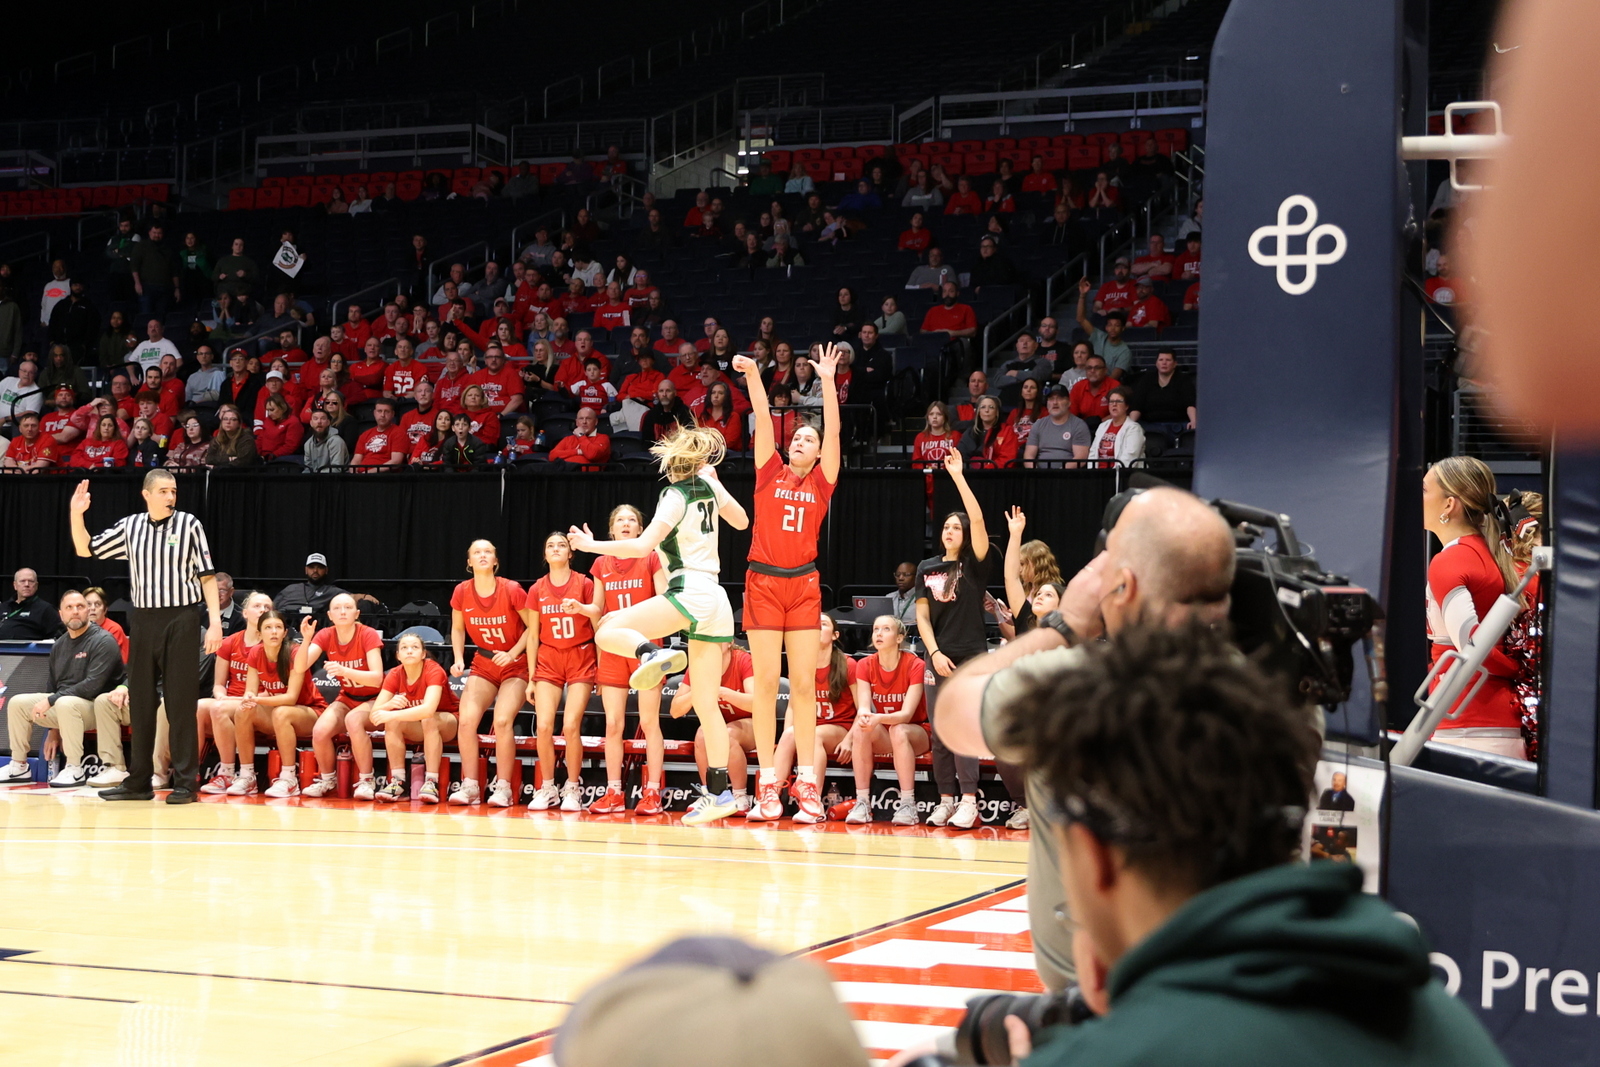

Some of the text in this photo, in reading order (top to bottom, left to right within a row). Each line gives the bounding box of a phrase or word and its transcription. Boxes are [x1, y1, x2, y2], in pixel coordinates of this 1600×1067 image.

[781, 505, 805, 532] 21
[605, 578, 643, 591] BELLEVUE
[469, 615, 507, 625] BELLEVUE
[541, 604, 564, 614] BELLE
[479, 627, 507, 645] 24
[550, 616, 575, 639] 20
[630, 784, 692, 810] Kger
[870, 787, 936, 813] Kroer
[1481, 950, 1600, 1016] Pre
